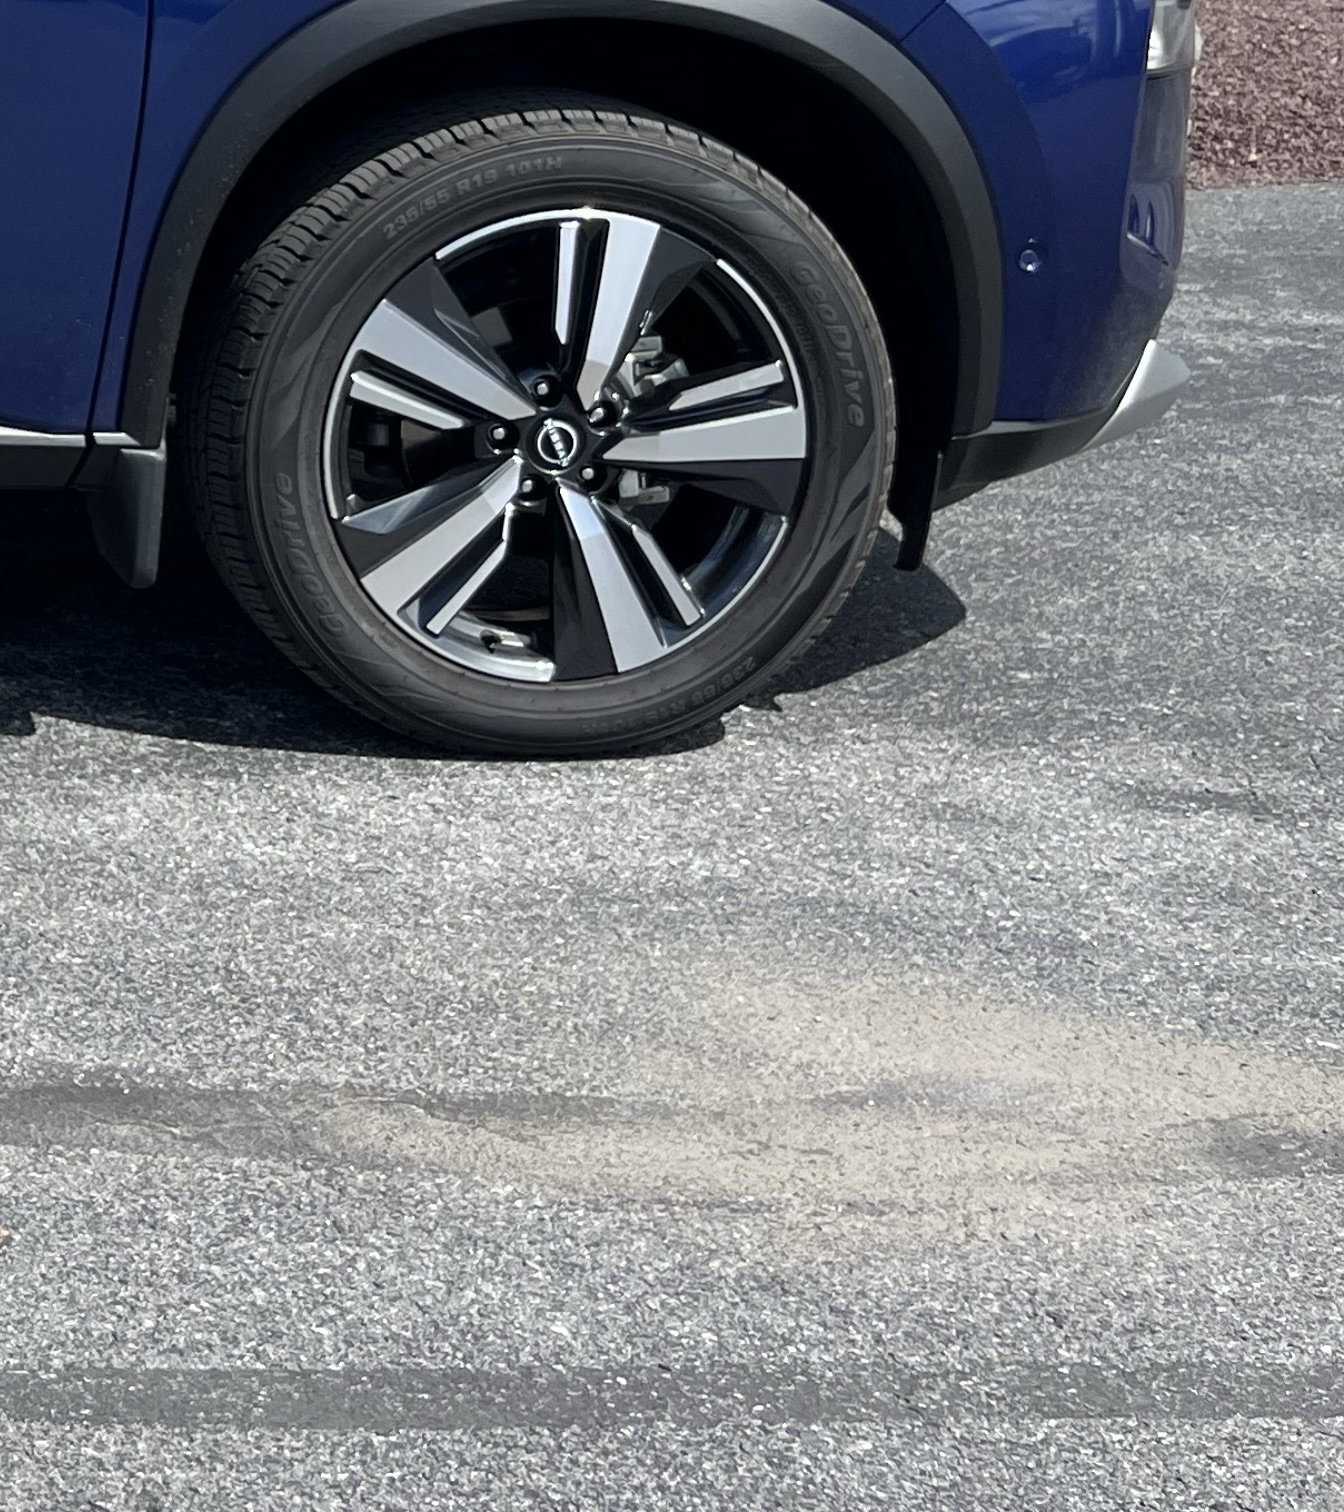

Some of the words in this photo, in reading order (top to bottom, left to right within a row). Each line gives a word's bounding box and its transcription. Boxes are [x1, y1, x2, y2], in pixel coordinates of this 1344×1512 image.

[382, 187, 451, 240] 235/55
[455, 168, 499, 196] R19
[506, 155, 563, 177] 101H
[789, 260, 865, 428] GeoDrive
[542, 417, 570, 468] NISSAN
[274, 471, 350, 638] GeoDrive
